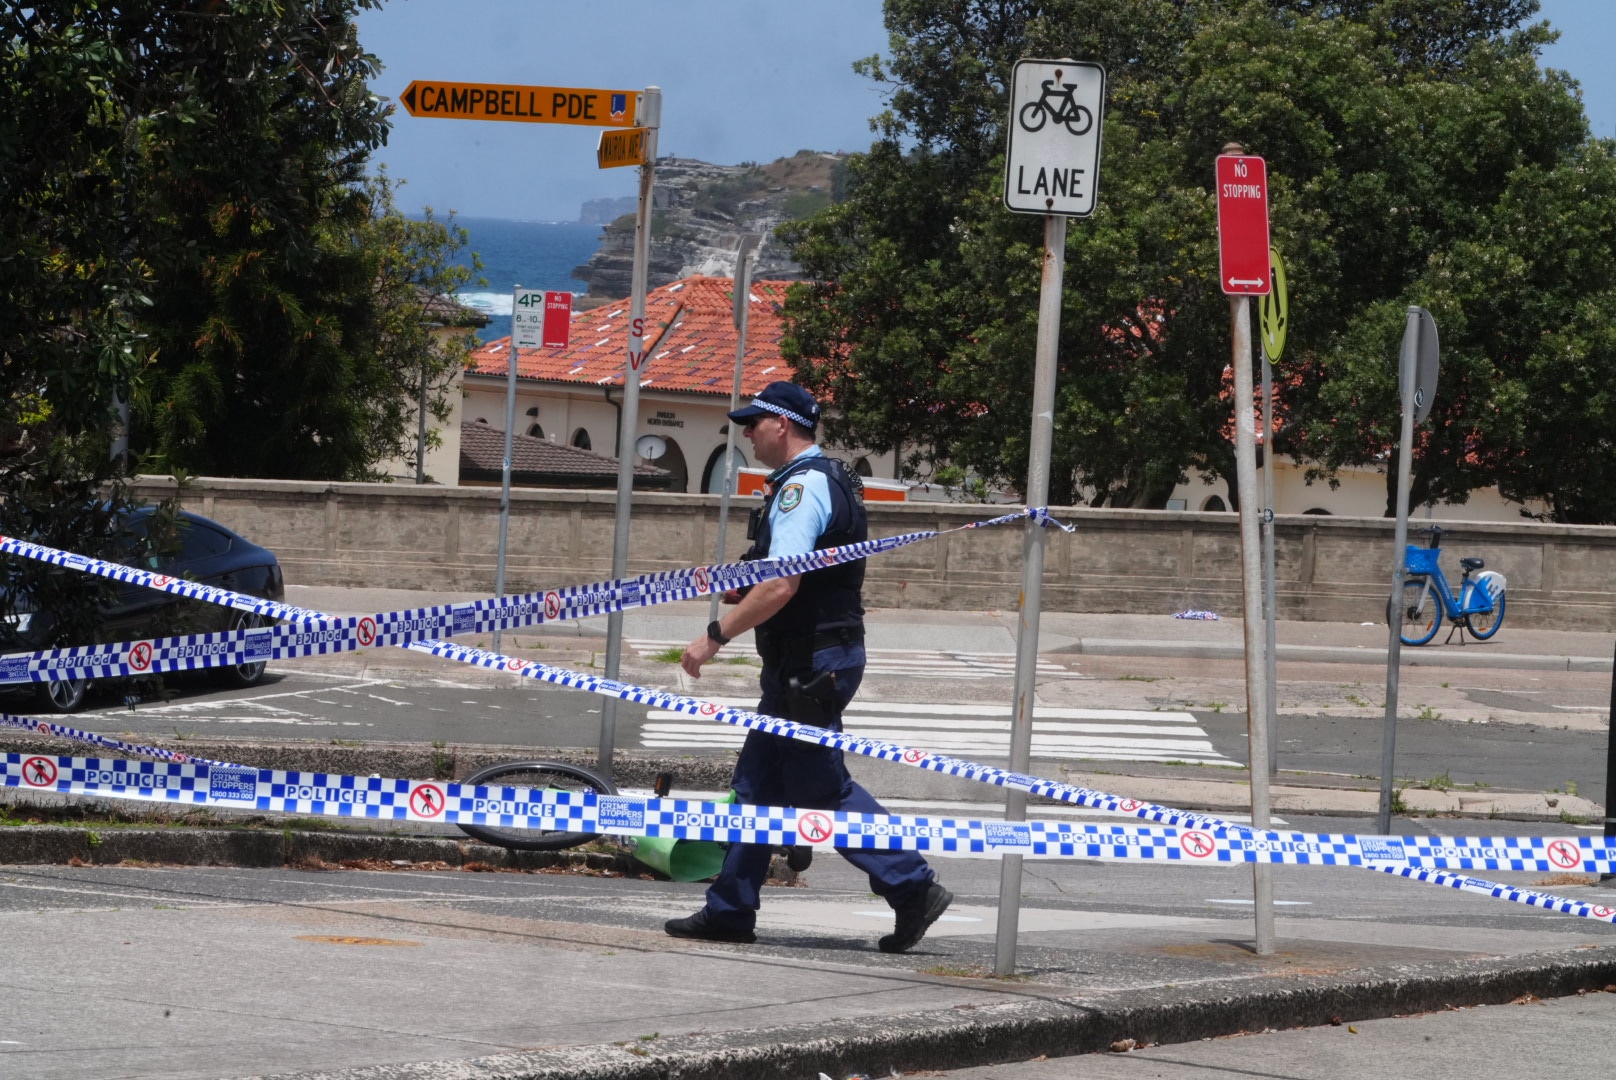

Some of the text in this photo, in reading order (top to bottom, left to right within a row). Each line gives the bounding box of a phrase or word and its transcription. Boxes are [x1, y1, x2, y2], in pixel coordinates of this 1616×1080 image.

[421, 86, 542, 117] CAMPBELL
[552, 93, 597, 119] PDE
[1234, 164, 1248, 178] NO
[1018, 165, 1084, 198] LANE
[1223, 184, 1261, 199] STOPPING
[518, 294, 542, 307] 4P
[547, 302, 568, 310] STOPPING
[632, 318, 644, 337] S
[630, 352, 642, 370] V
[655, 578, 686, 592] POLICE
[577, 591, 610, 606] POLICE
[495, 604, 532, 619] POLICE
[398, 617, 439, 632] POLICE
[297, 630, 340, 645] POLICE
[178, 642, 228, 657] POLICE
[245, 641, 271, 650] STOPPERS
[254, 648, 270, 656] CRIME
[58, 654, 110, 668] POLICE
[8, 670, 27, 678] CRIME
[87, 771, 164, 788] POLICE
[212, 773, 240, 781] CRIME
[211, 781, 254, 791] STOPPERS
[287, 786, 365, 803] POLICE
[475, 800, 553, 816] POLICE
[601, 802, 629, 810] CRIME
[600, 809, 643, 819] STOPPERS
[676, 813, 753, 829] POLICE
[864, 825, 940, 837] POLICE
[987, 830, 1029, 838] STOPPERS
[1062, 833, 1137, 845] POLICE
[1244, 840, 1318, 853] POLICE
[1433, 847, 1506, 858] POLICE
